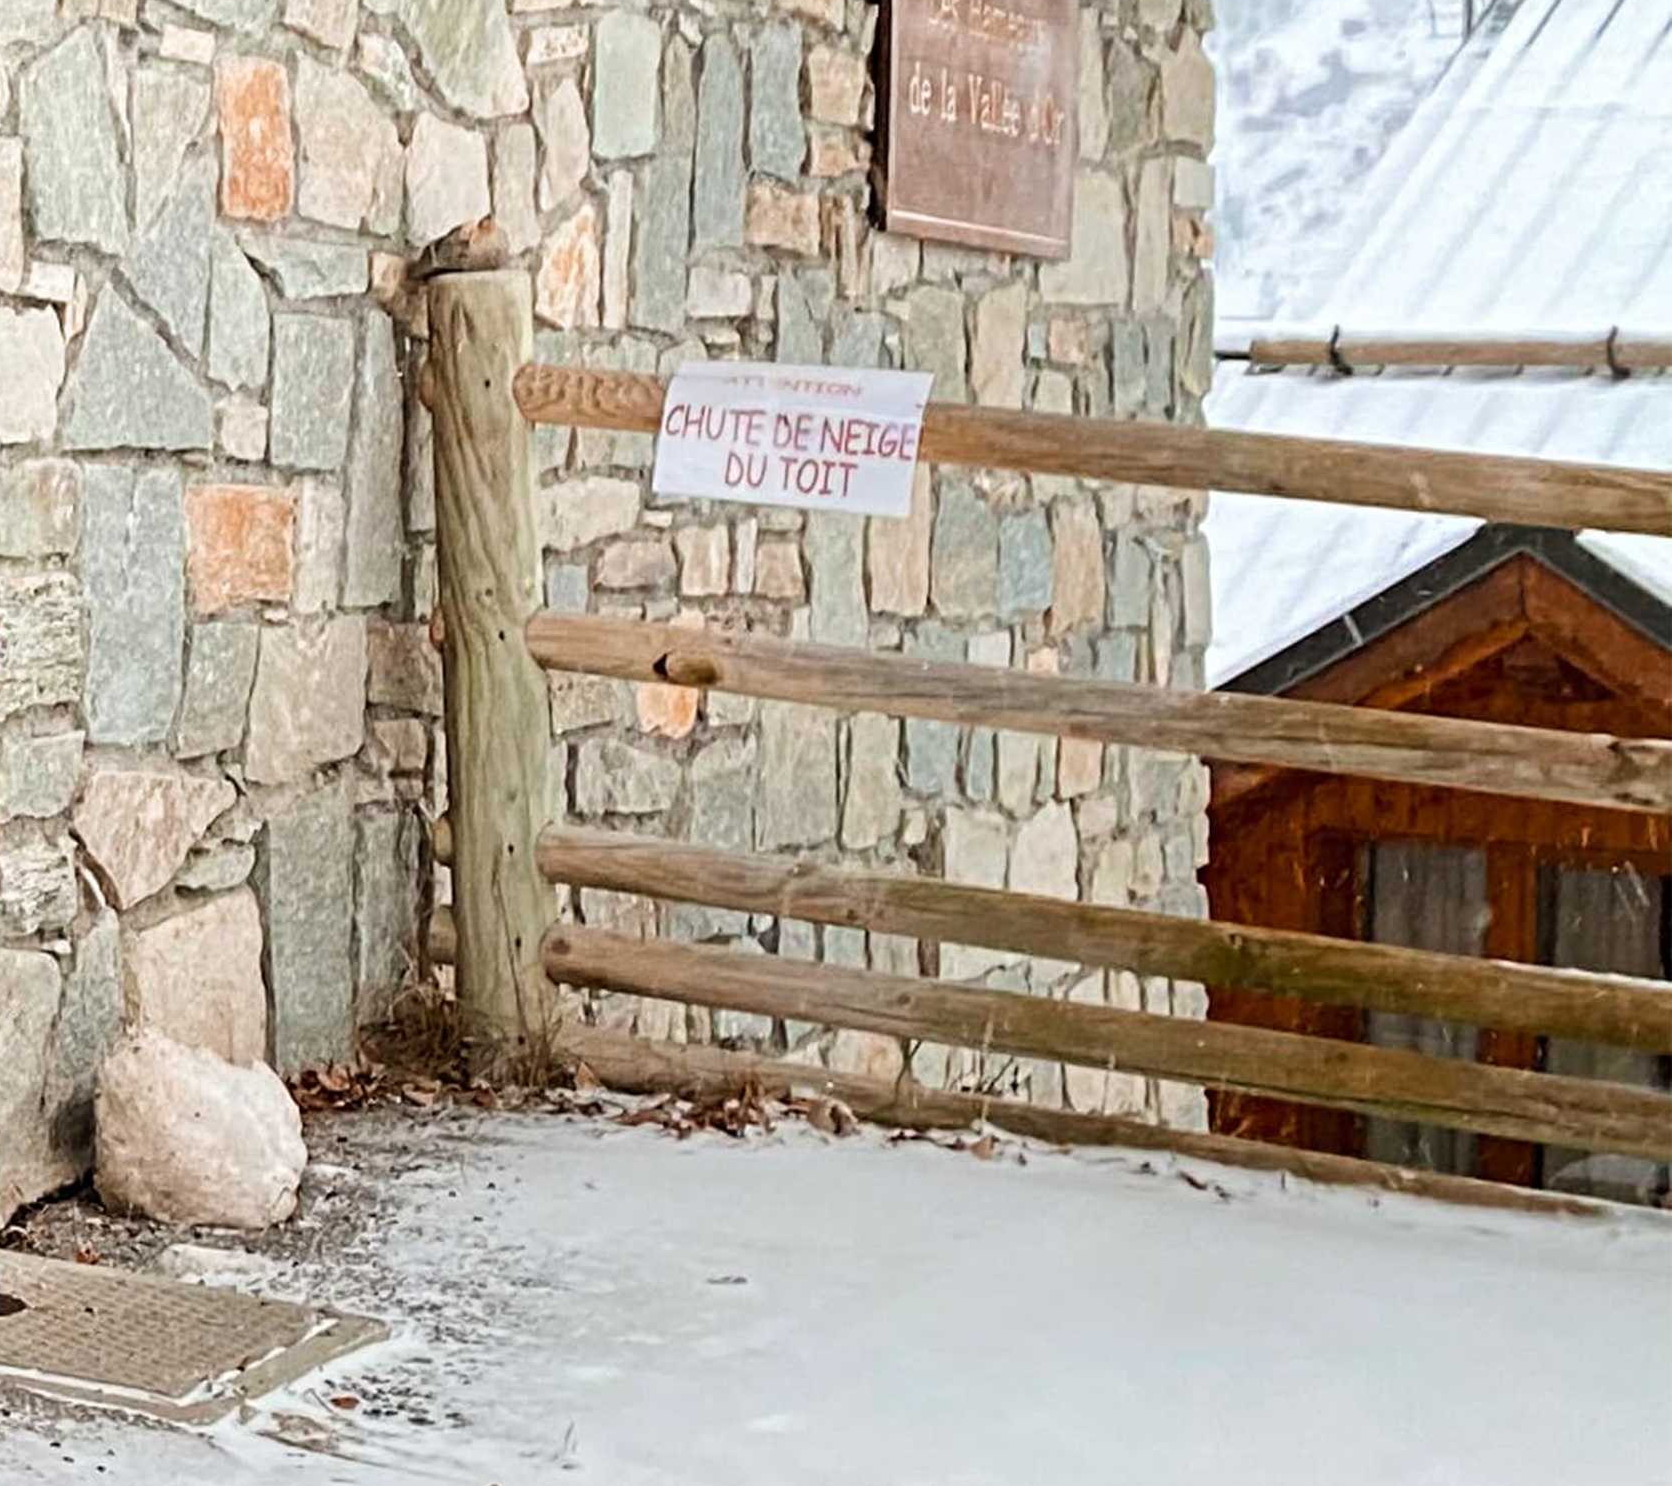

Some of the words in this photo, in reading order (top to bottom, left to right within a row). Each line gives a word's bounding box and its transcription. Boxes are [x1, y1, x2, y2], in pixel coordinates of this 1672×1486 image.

[909, 60, 933, 116] de
[940, 67, 958, 123] la
[664, 403, 767, 448] CHUTE
[772, 413, 813, 452] DE
[819, 416, 917, 462] NEIGE
[724, 451, 768, 489] DU
[779, 456, 859, 498] TOIT
